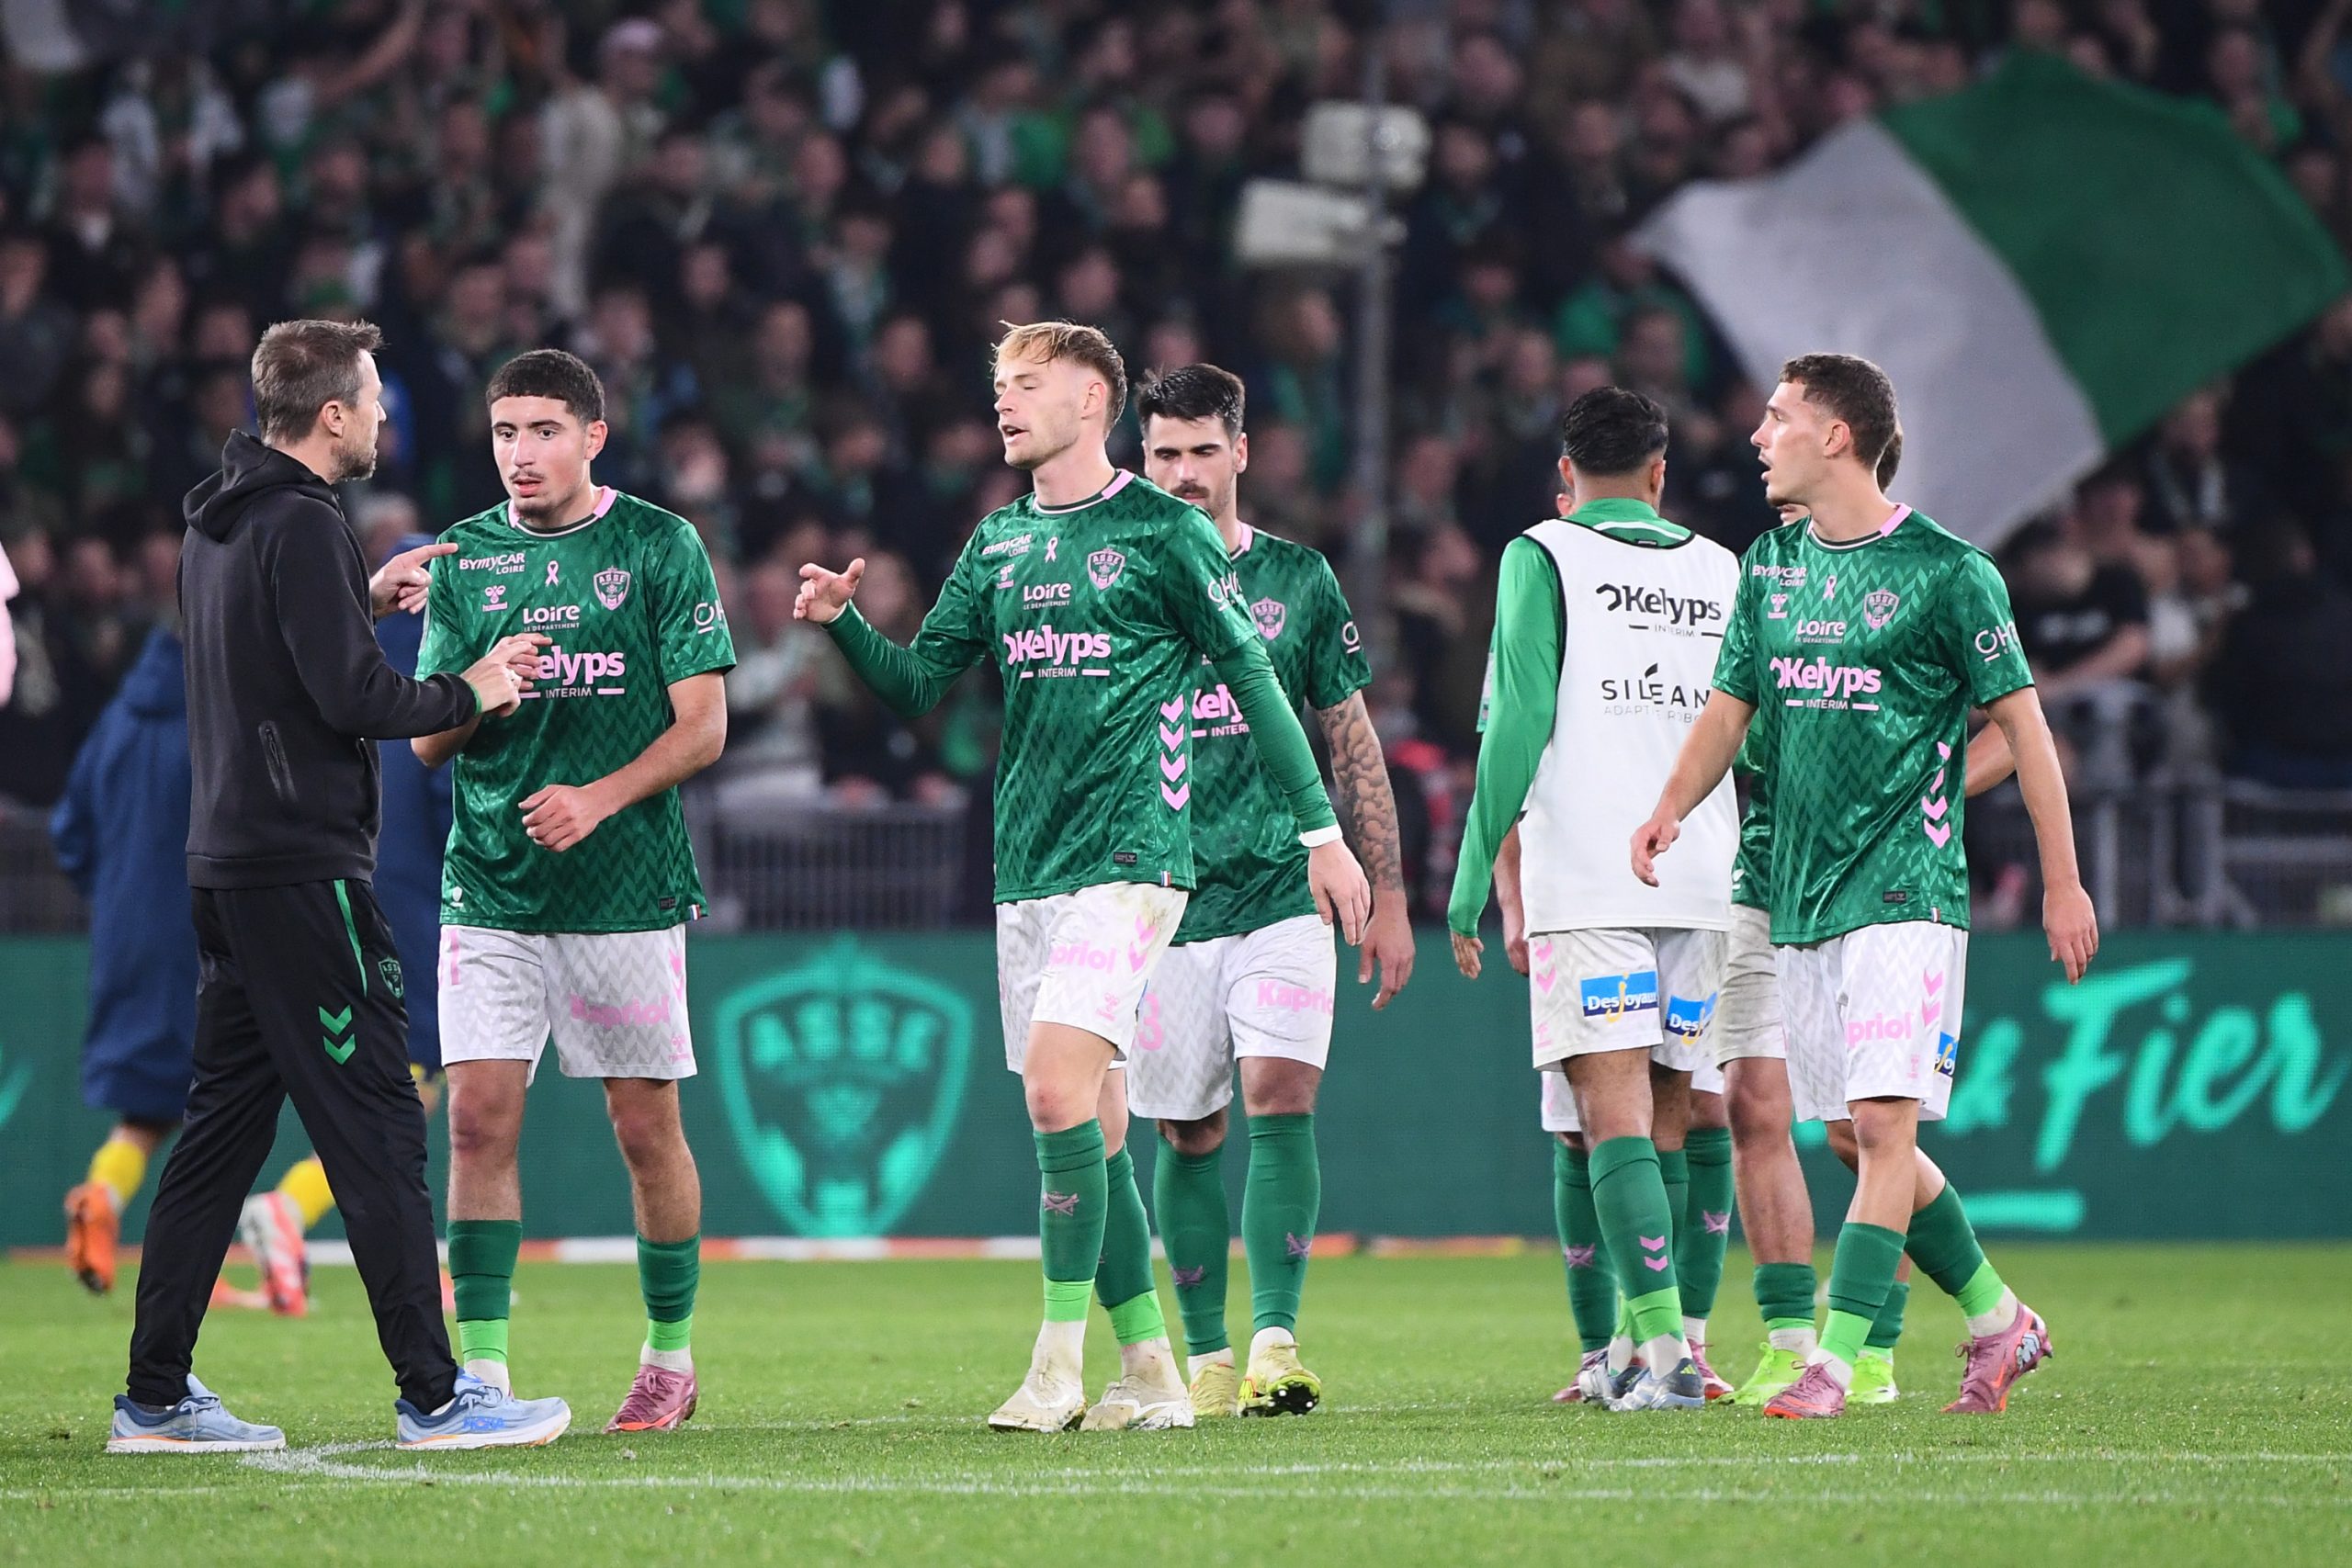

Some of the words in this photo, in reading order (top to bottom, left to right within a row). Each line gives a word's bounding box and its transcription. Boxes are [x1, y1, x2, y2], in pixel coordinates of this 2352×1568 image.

[496, 565, 526, 575] LOIRE
[1023, 582, 1071, 602] Loire
[523, 604, 581, 625] Loire
[1623, 584, 1722, 626] Kelyps
[1796, 619, 1846, 637] Loire
[1015, 625, 1112, 666] Kelyps
[537, 645, 626, 686] elyps
[1038, 668, 1077, 678] INTERIM
[1783, 657, 1882, 698] Kelyps
[545, 687, 593, 699] INTERIM
[1806, 699, 1849, 710] INTERIM
[2034, 956, 2350, 1173] Fier
